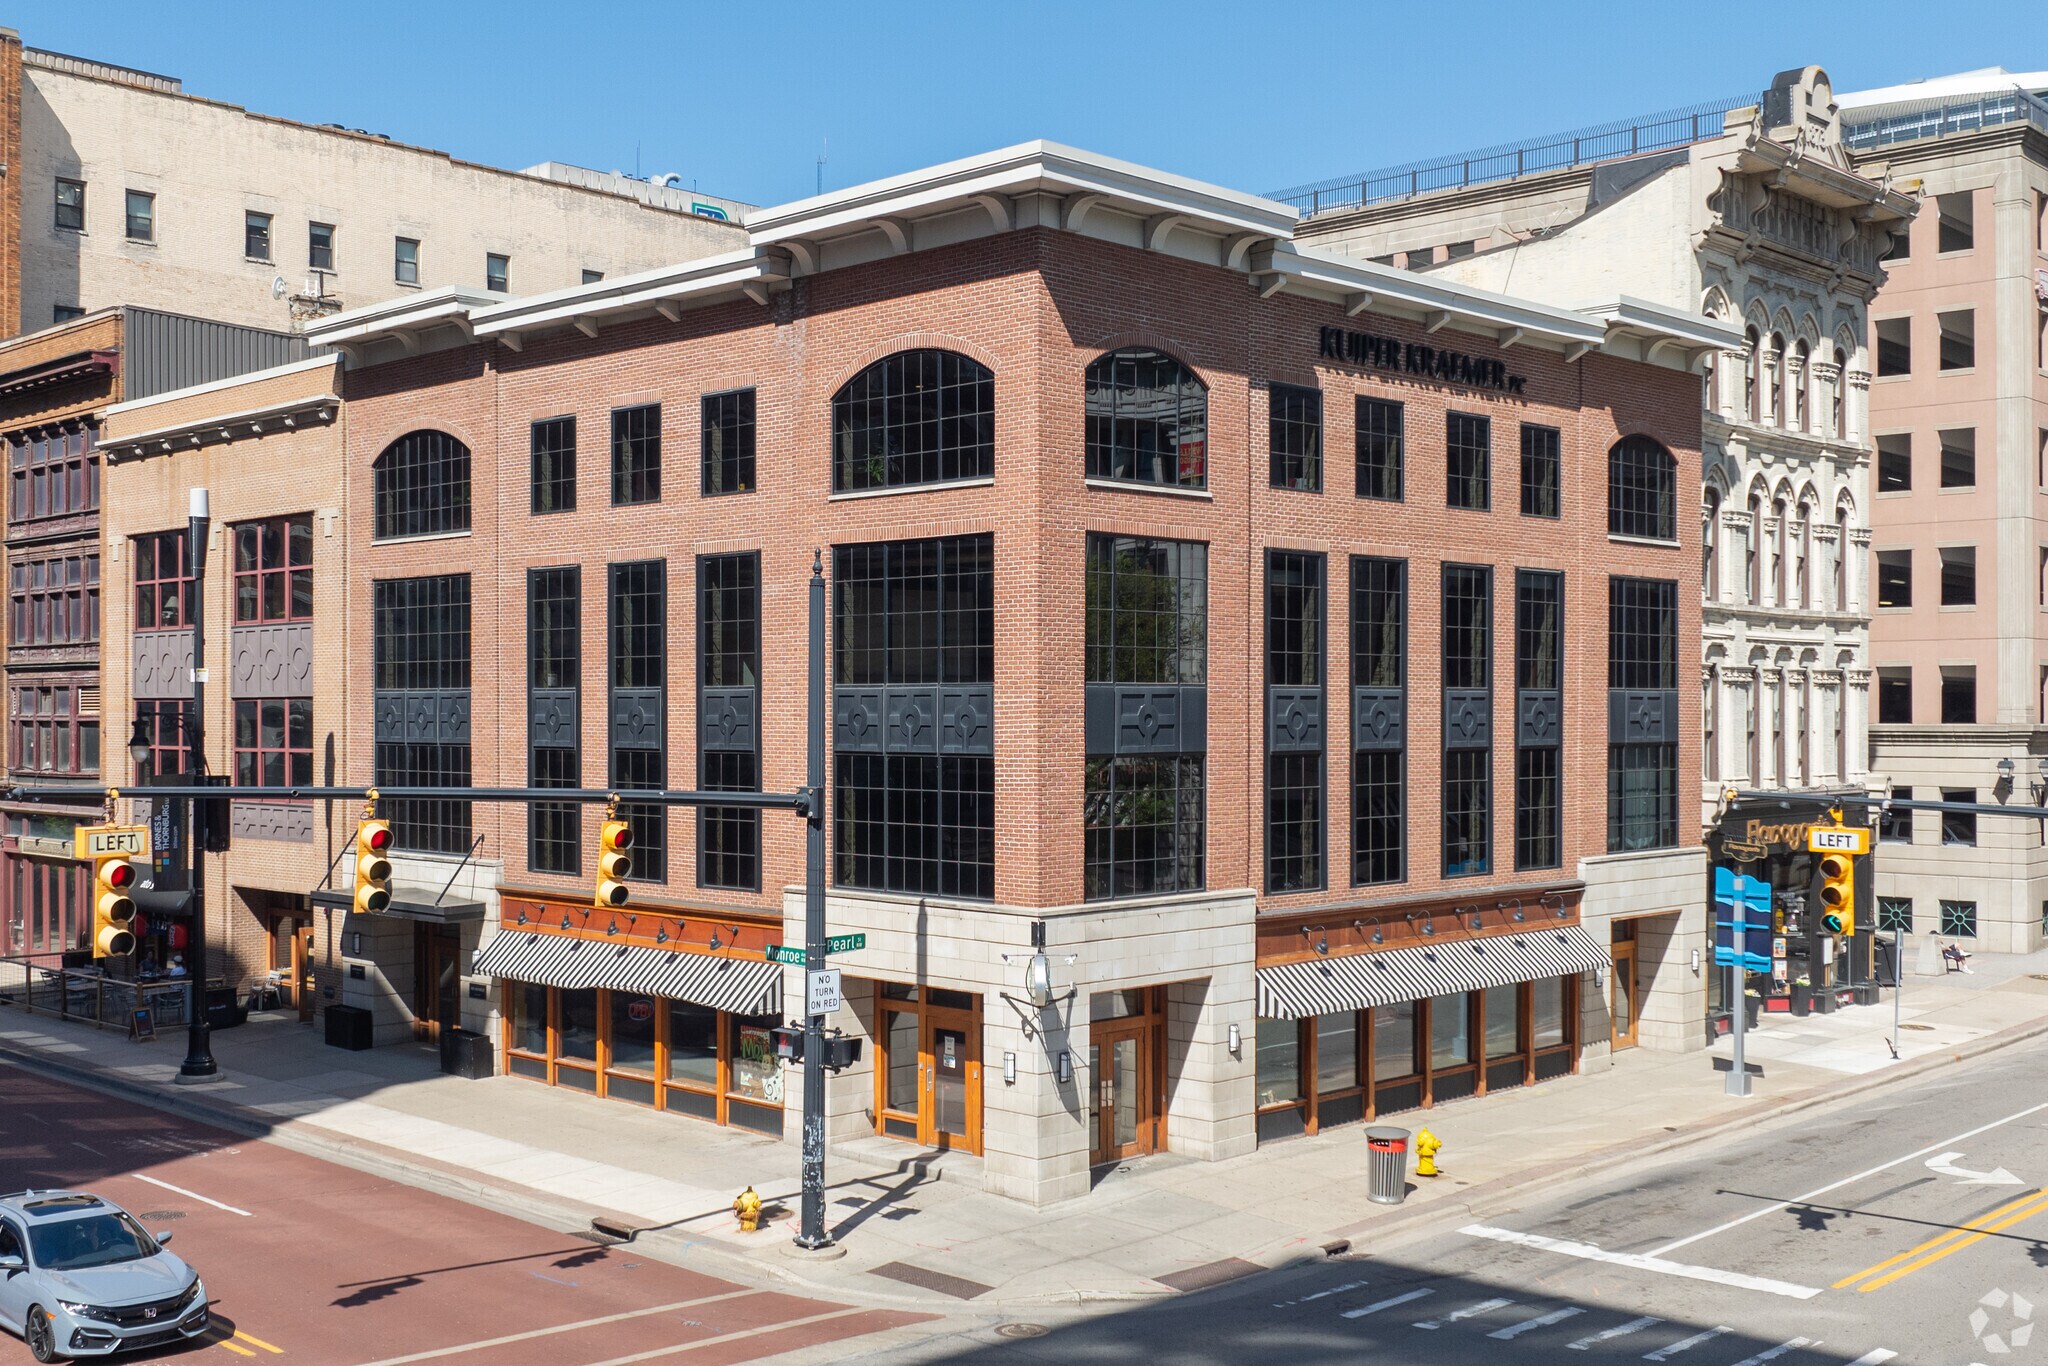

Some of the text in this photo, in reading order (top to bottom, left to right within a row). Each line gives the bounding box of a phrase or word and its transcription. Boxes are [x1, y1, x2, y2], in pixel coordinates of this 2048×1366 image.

[1320, 326, 1401, 370] KUIPER
[1405, 343, 1506, 390] KRAEMER
[96, 834, 136, 851] LEFT
[1818, 834, 1852, 848] LEFT
[827, 936, 855, 951] Pearl
[767, 946, 800, 963] Monroe
[818, 975, 830, 984] NO
[815, 987, 834, 997] TURN
[811, 998, 838, 1009] ON RED
